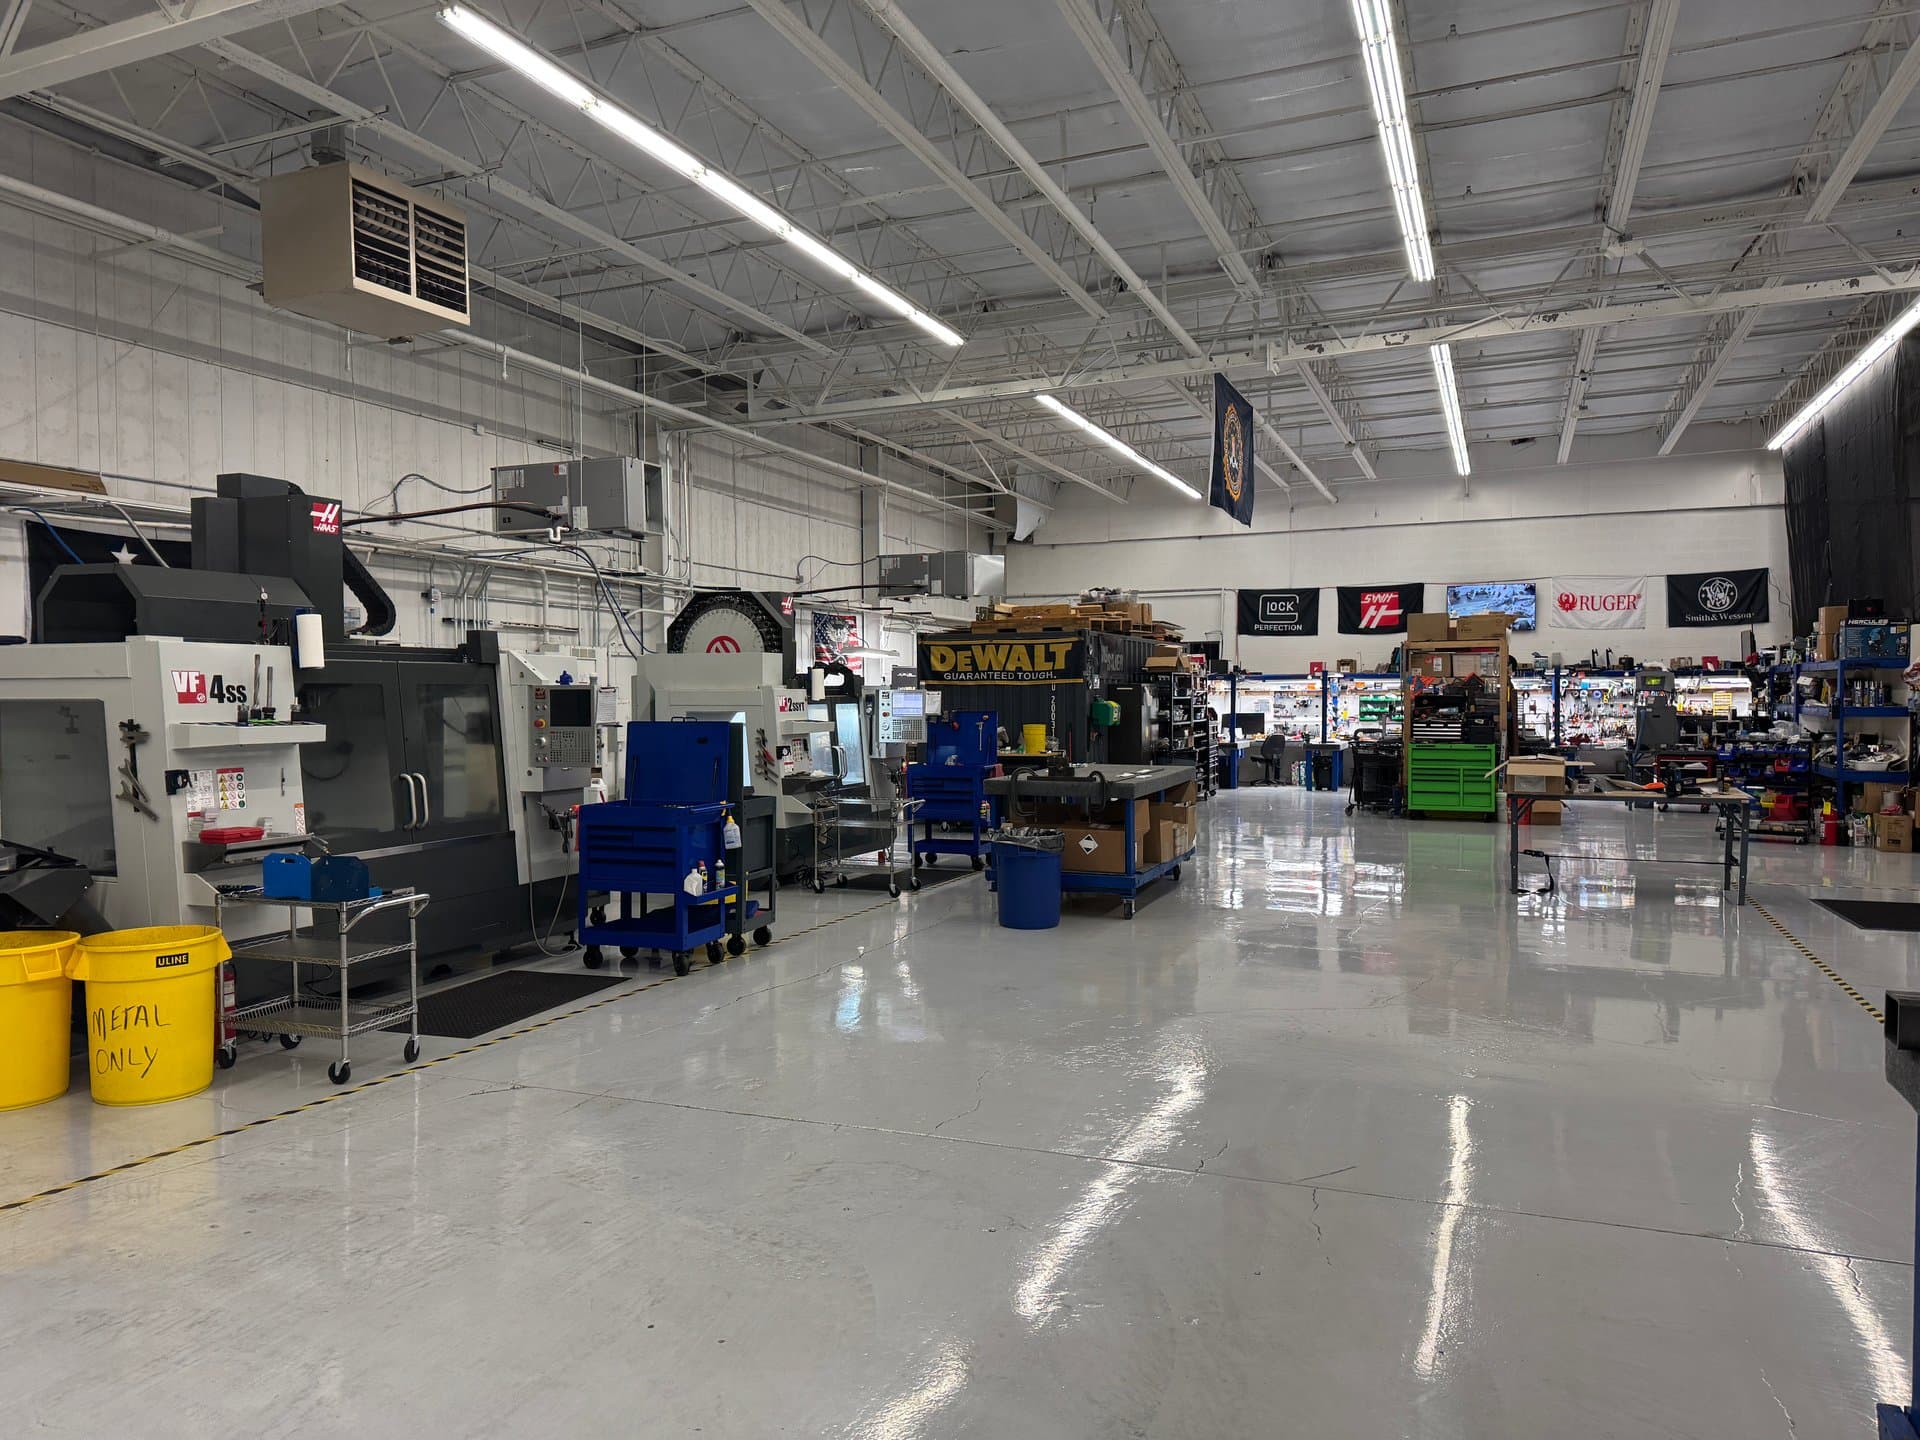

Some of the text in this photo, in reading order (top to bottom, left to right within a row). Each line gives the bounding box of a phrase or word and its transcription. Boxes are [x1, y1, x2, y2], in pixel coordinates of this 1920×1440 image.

[171, 670, 200, 693] VF
[944, 671, 1057, 681] GUARANTEED TOUGH.
[158, 954, 188, 966] ULINE
[92, 1004, 172, 1042] METAL
[96, 1046, 159, 1079] ONLY
